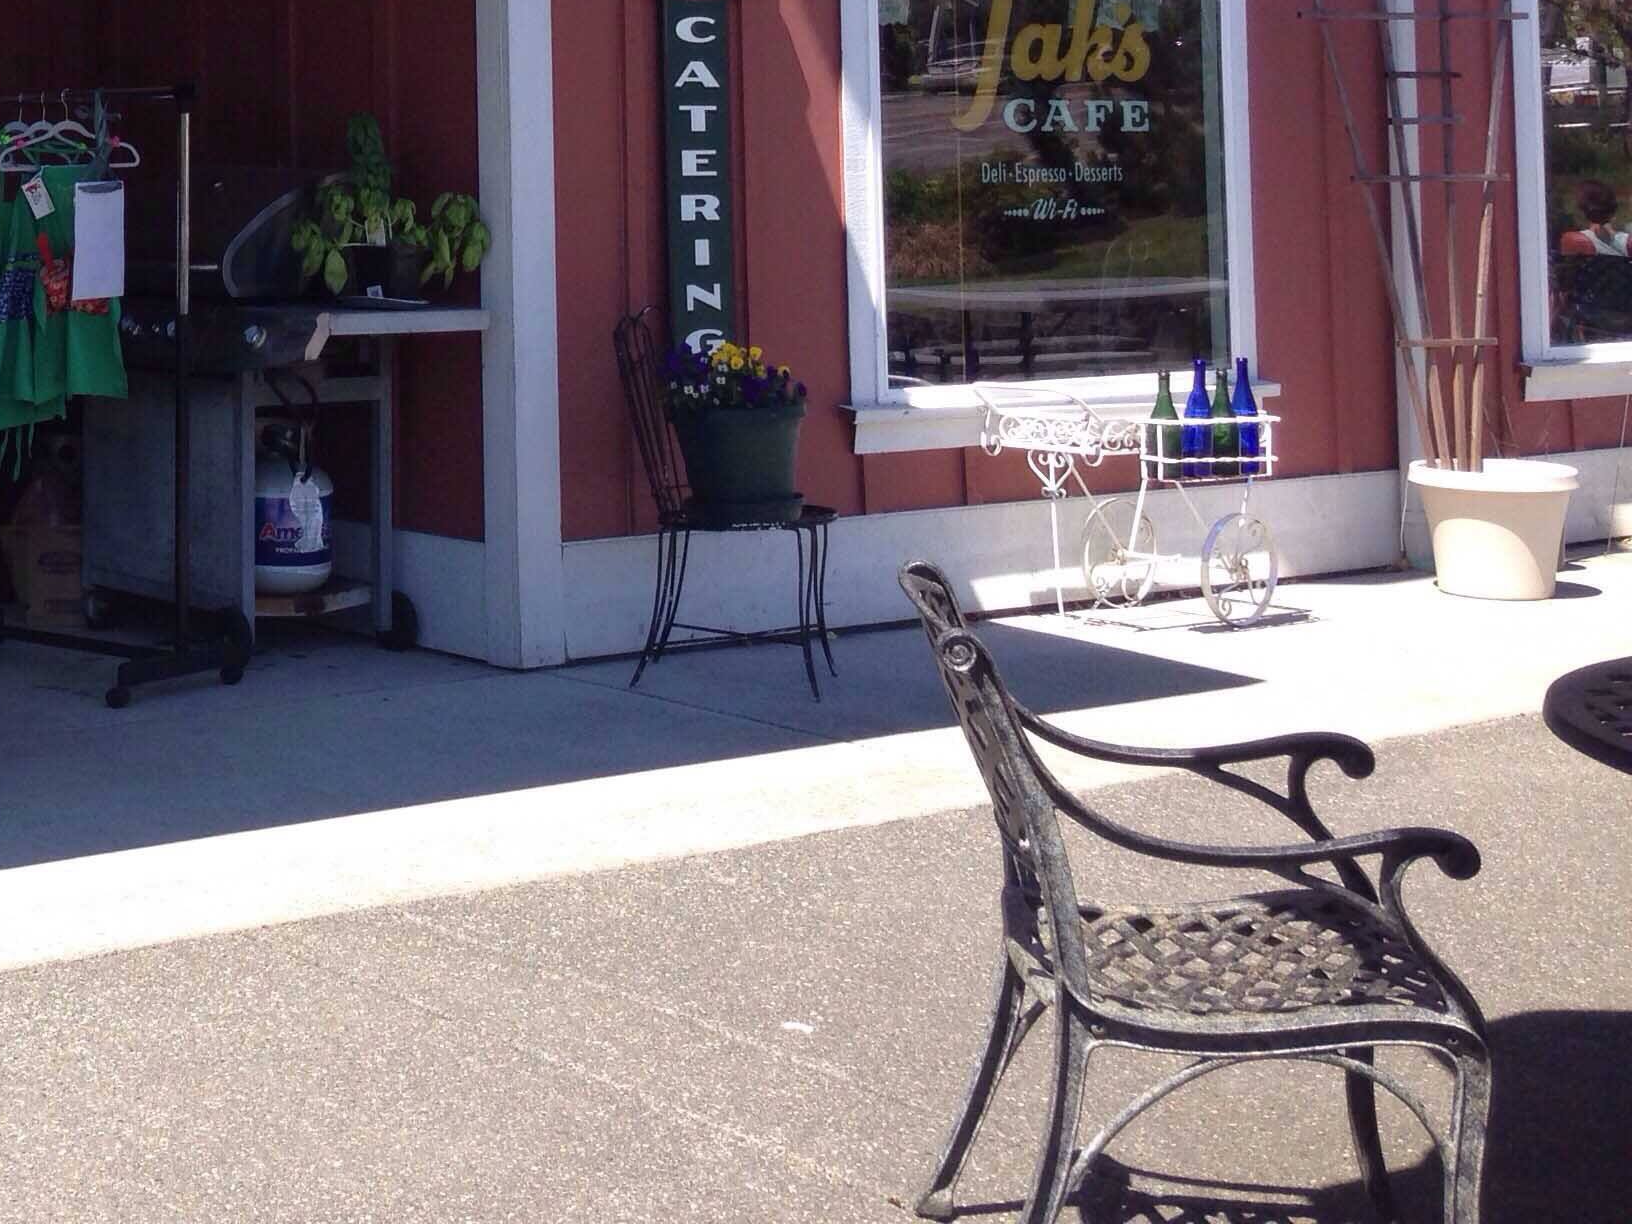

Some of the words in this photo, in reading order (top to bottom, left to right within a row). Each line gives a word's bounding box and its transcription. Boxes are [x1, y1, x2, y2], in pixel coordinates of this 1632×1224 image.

[1002, 97, 1151, 133] CAFE
[673, 15, 723, 357] CATERING
[980, 161, 1007, 184] Deli
[1015, 161, 1067, 187] Espresso
[1074, 161, 1124, 183] Desserts
